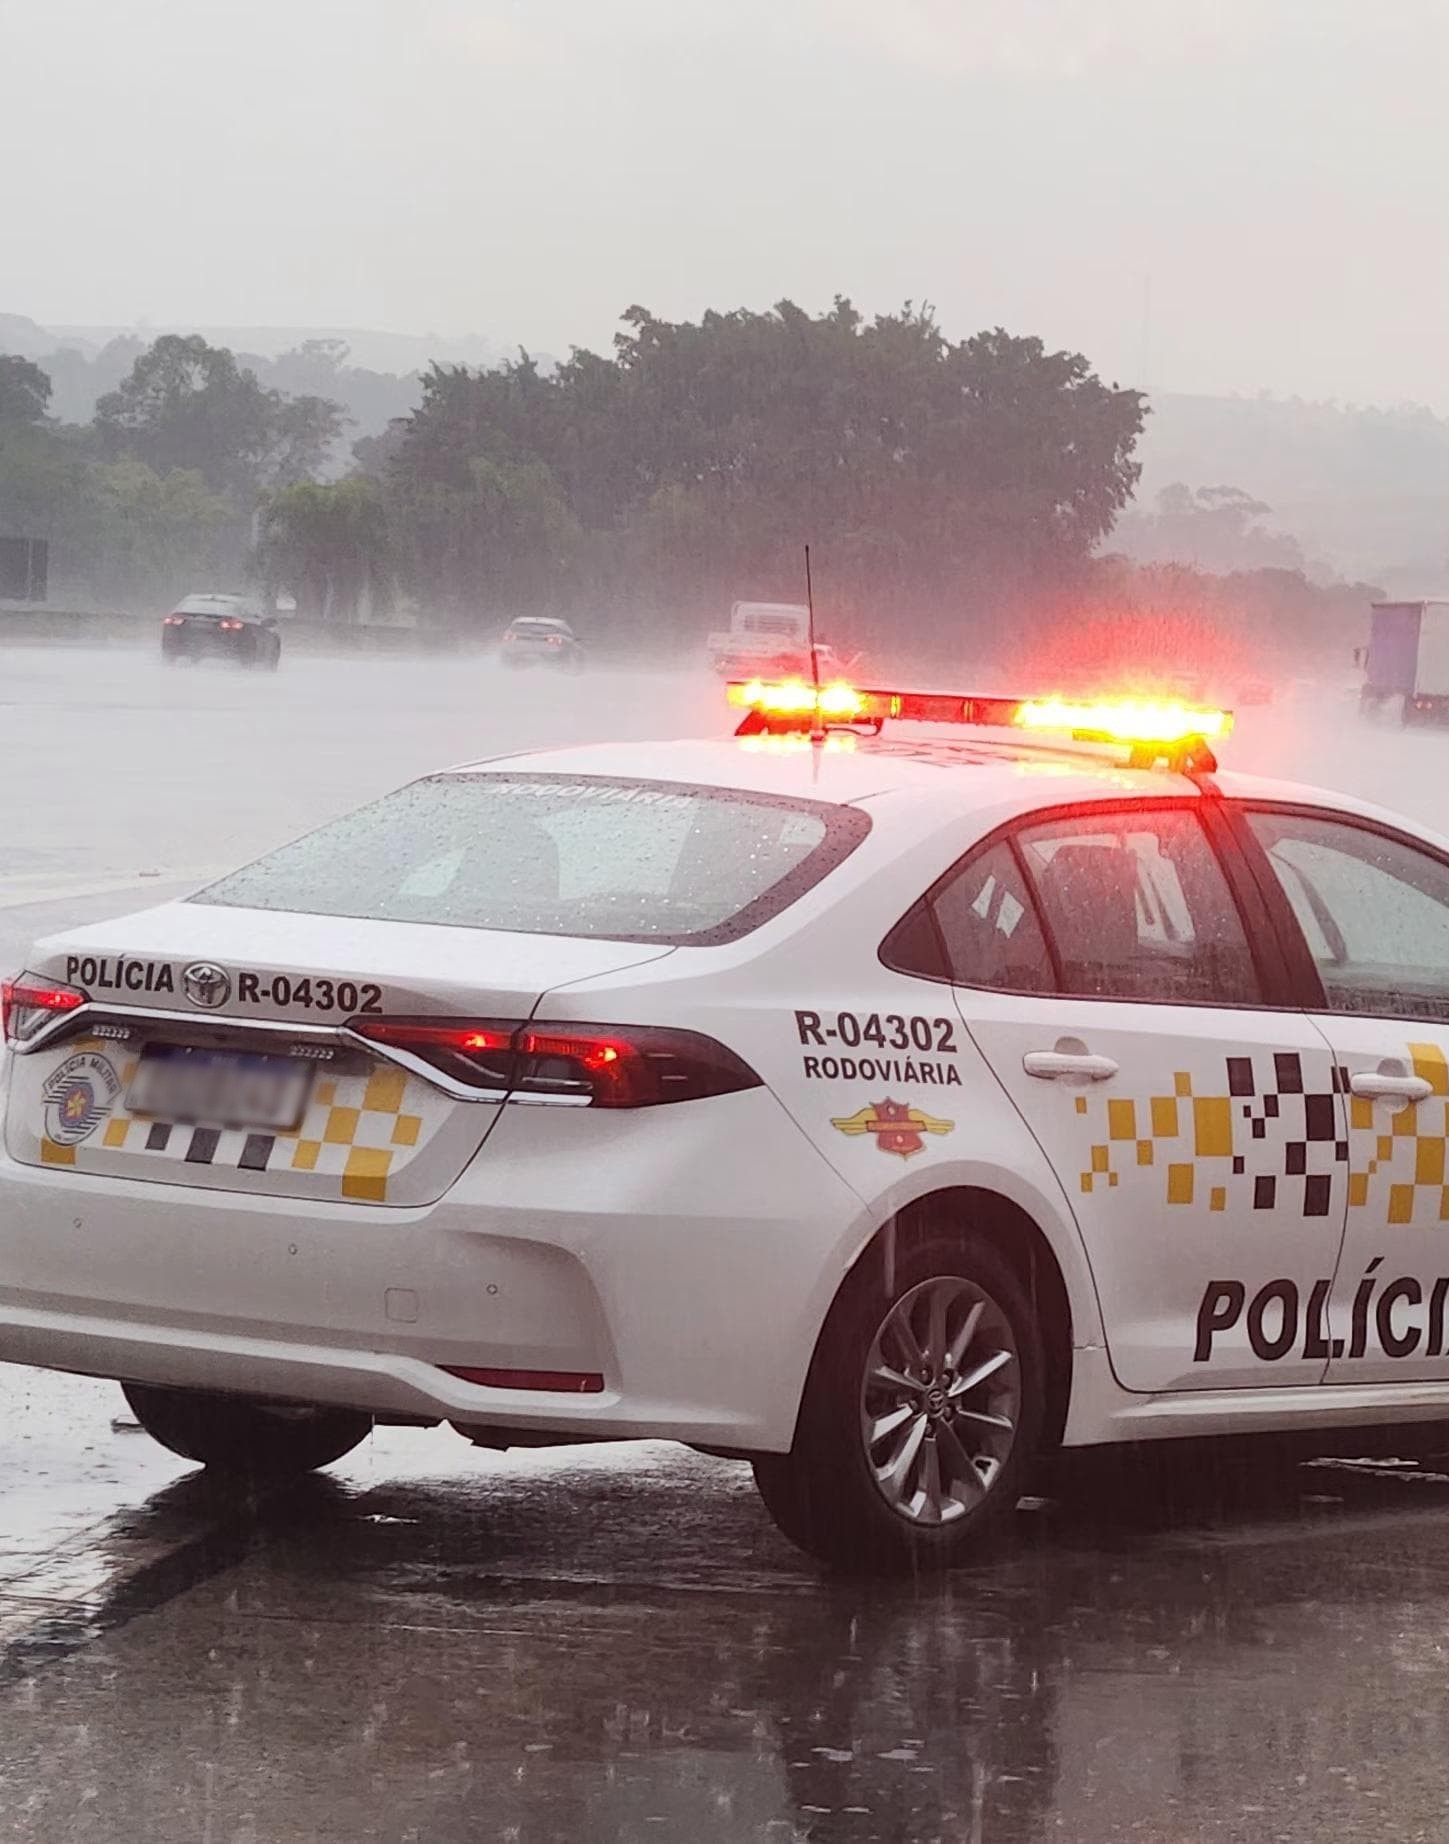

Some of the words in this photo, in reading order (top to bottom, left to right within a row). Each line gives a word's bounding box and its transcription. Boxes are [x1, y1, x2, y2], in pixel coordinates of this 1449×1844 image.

[66, 952, 175, 994] POLÍCIA
[238, 972, 384, 1014] R-04302
[794, 1009, 958, 1053] R-04302
[803, 1056, 963, 1086] RODOVIÁRIA
